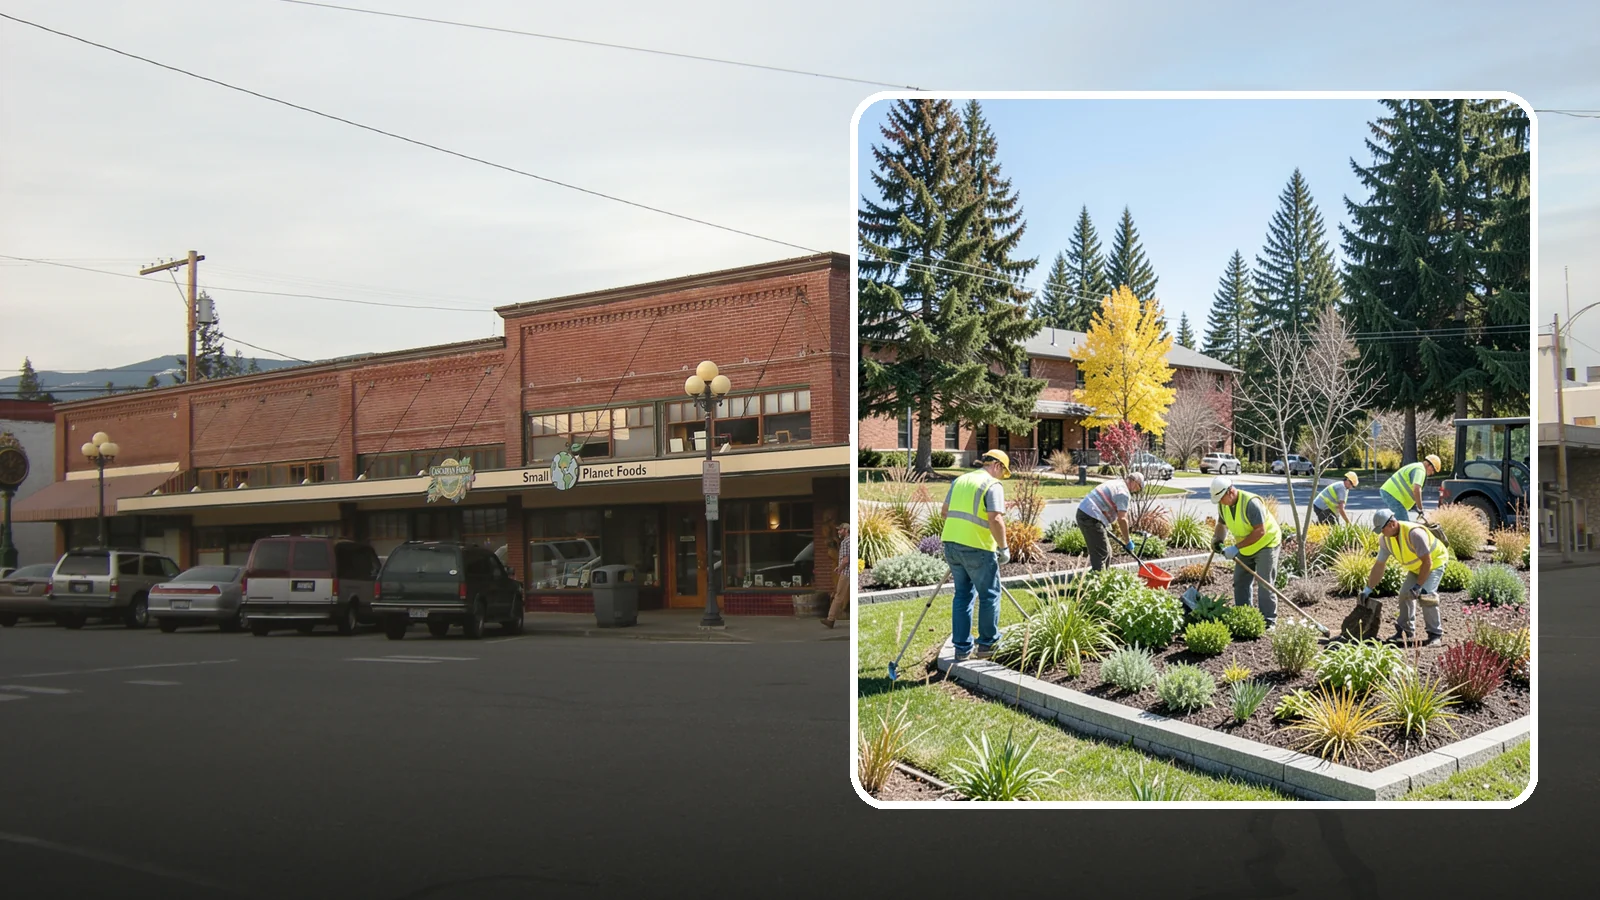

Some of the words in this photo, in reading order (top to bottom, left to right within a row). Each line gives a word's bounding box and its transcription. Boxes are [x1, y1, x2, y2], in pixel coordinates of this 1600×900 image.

[523, 470, 549, 482] Small
[582, 468, 614, 479] Planet
[616, 464, 647, 477] Foods
